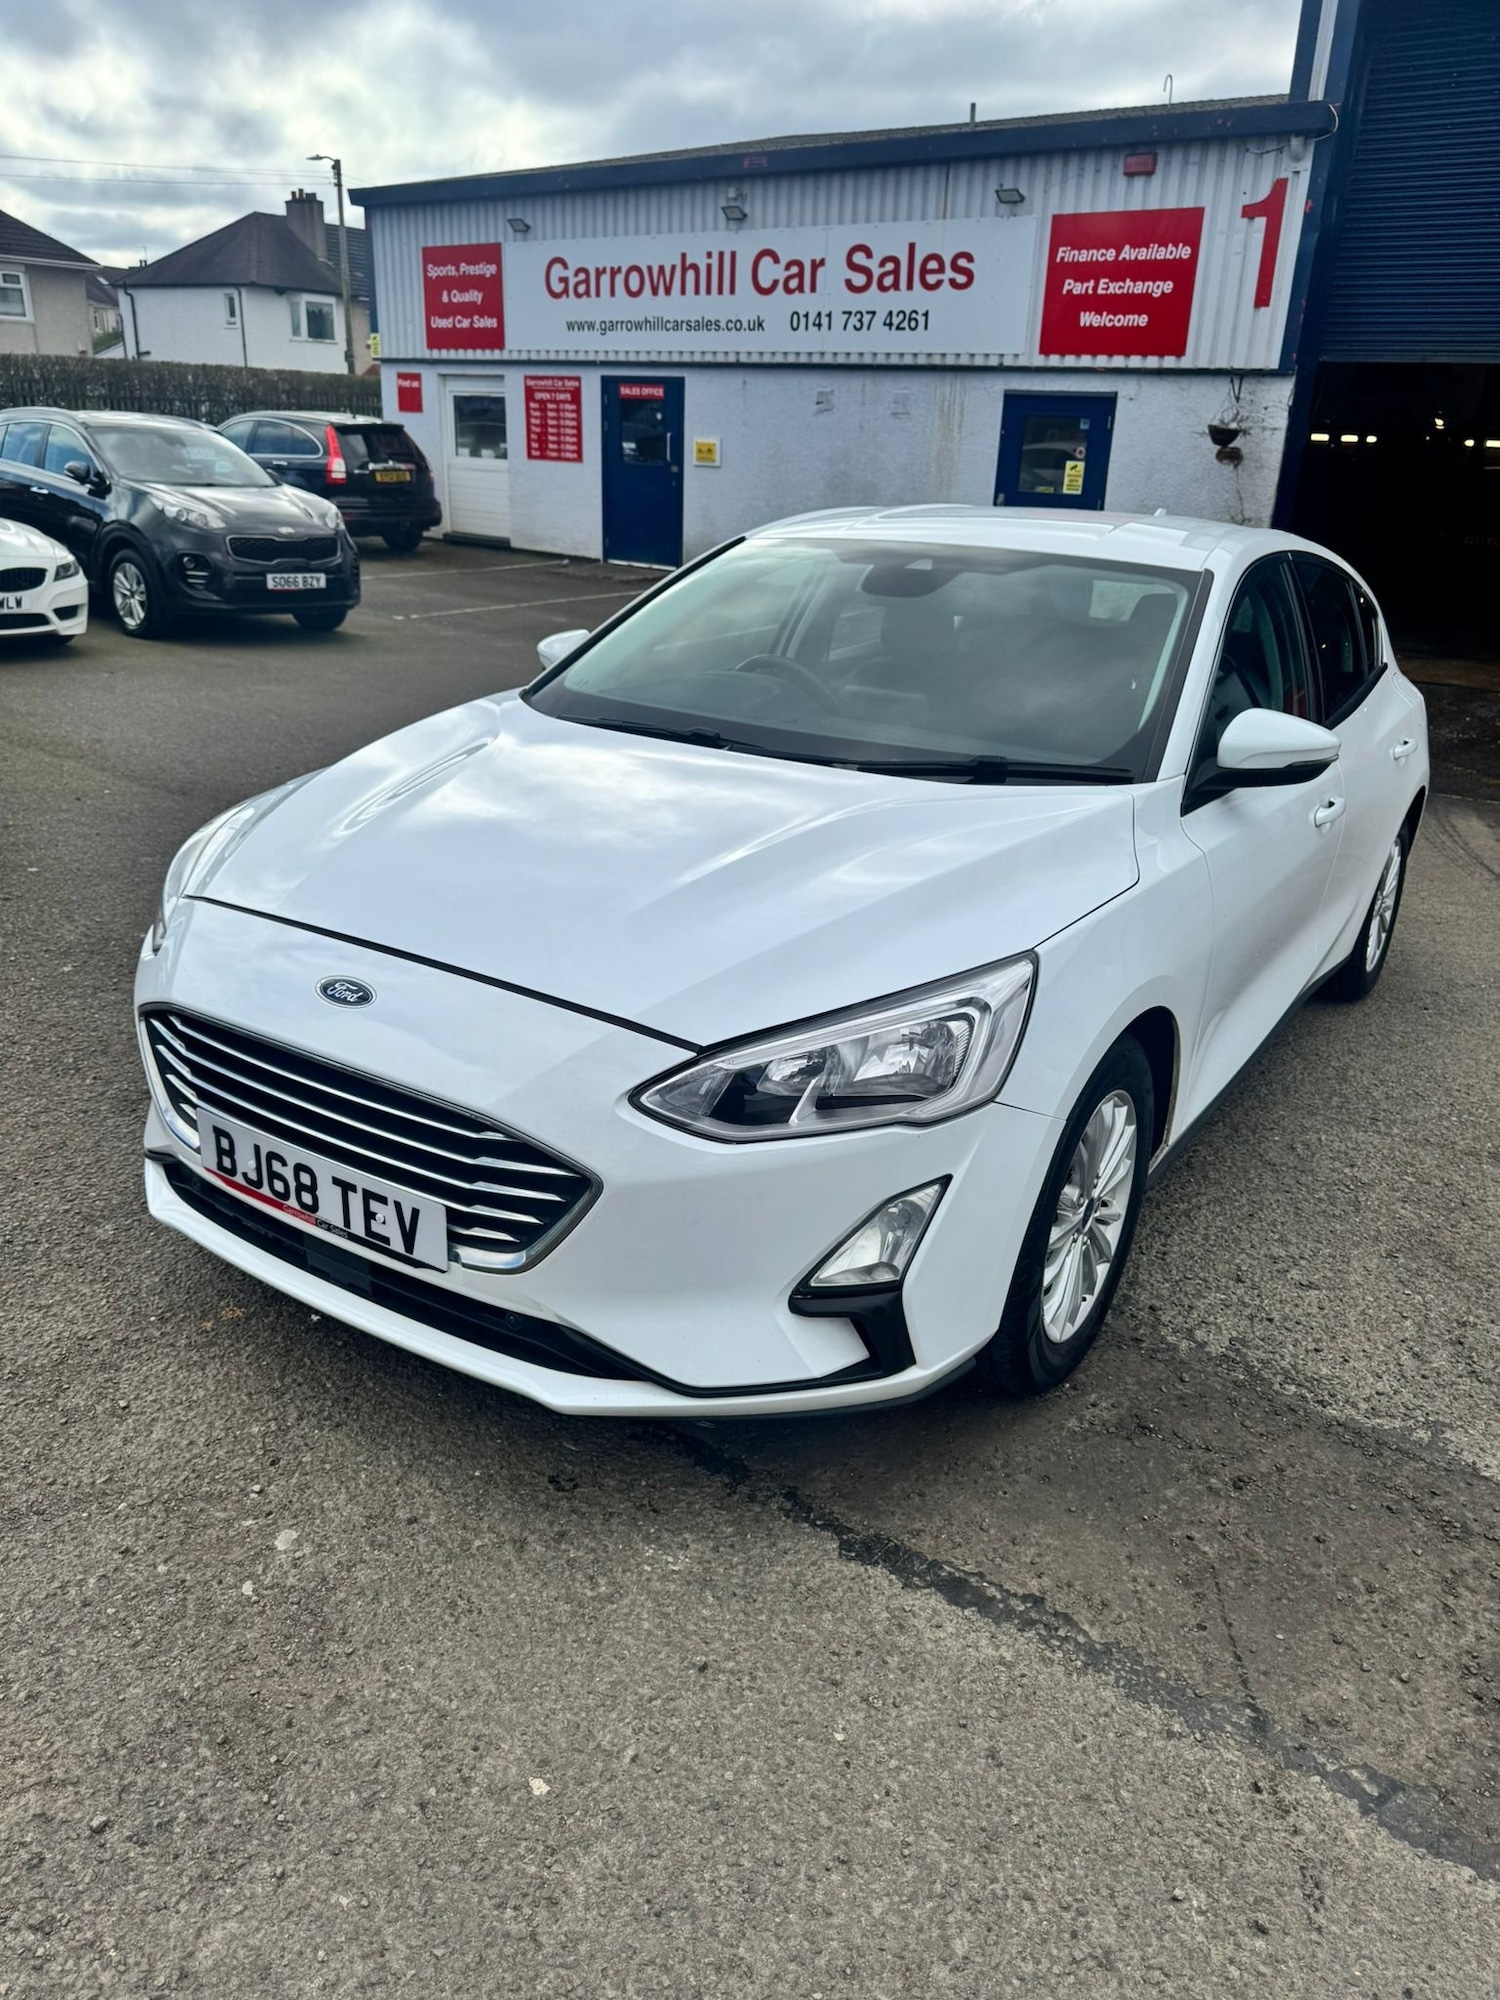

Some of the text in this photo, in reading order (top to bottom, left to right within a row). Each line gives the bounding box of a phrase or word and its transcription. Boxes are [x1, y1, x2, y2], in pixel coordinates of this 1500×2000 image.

[1241, 177, 1289, 308] 1
[1056, 243, 1192, 262] Finance Available
[427, 262, 498, 279] Sports, Prestige
[545, 242, 975, 299] Garrowhill Car Sales
[442, 289, 483, 305] & Quality
[1062, 278, 1174, 297] Part Exchange
[430, 315, 498, 328] Used Car Sales
[566, 315, 765, 336] www.garrowhillcarsales.co.uk
[790, 309, 930, 331] 0141 737 4261
[1079, 311, 1149, 327] Welcome
[554, 379, 563, 387] Car
[564, 379, 580, 387] Sales
[620, 386, 664, 397] SALES OFFICE
[534, 391, 550, 400] OPEN
[556, 392, 571, 401] DAYS
[272, 576, 321, 588] SO66 BZY
[327, 981, 364, 1002] Ford
[212, 1125, 420, 1255] BJ68 TEV
[317, 1219, 329, 1231] Car
[329, 1223, 349, 1239] Sales
